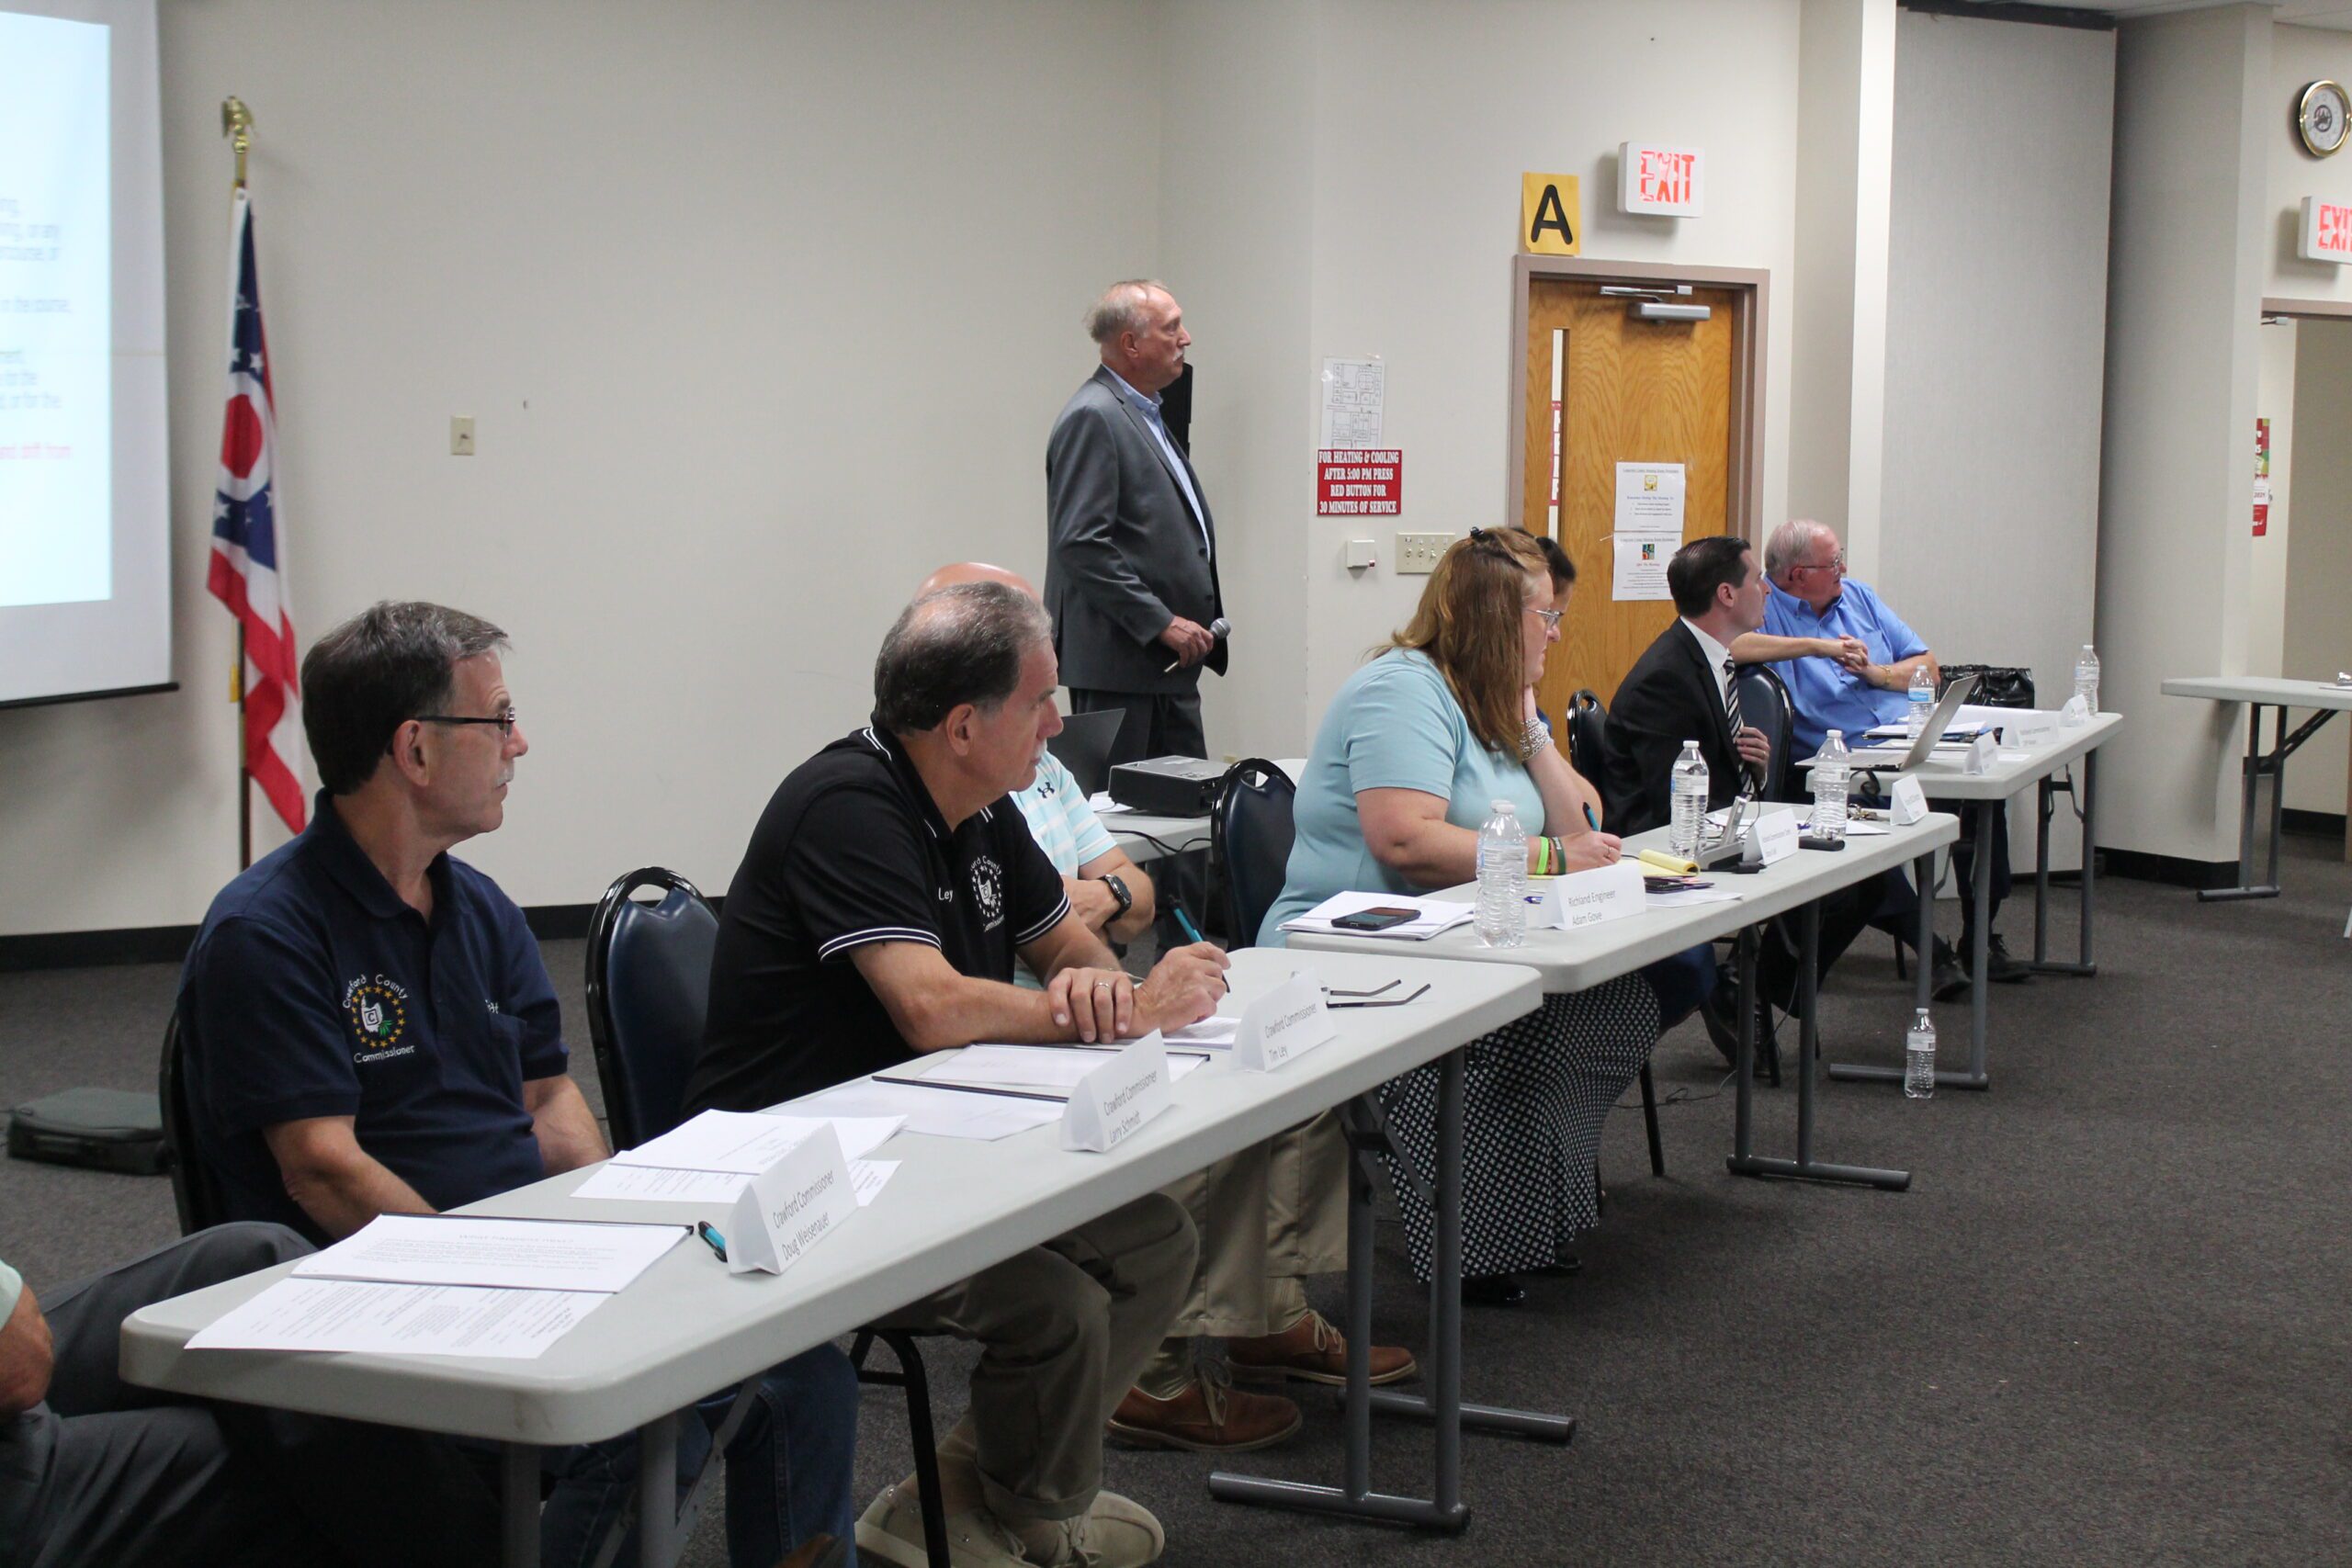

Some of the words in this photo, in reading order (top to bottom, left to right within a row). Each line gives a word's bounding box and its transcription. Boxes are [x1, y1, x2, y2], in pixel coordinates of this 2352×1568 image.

[1639, 150, 1695, 205] EXIT
[1530, 184, 1574, 245] A
[1318, 451, 1332, 464] FOR
[1333, 451, 1363, 464] HEATING
[1363, 451, 1370, 464] &
[1371, 451, 1399, 464] COOLING
[1324, 468, 1346, 480] AFTER
[1347, 468, 1360, 480] 5:00
[1361, 468, 1372, 480] PM
[1373, 468, 1394, 480] PRESS
[1329, 484, 1344, 497] RED
[1345, 484, 1372, 497] BUTTON
[1373, 484, 1386, 497] FOR
[1319, 501, 1328, 513] 30
[1329, 501, 1358, 513] MINUTES
[1359, 501, 1368, 513] OF
[1369, 501, 1396, 513] SERVICE
[938, 886, 954, 903] Ley
[1591, 890, 1616, 904] Engineer
[375, 974, 408, 999] County
[1283, 1003, 1317, 1028] Commissioner
[354, 1044, 416, 1064] Commissioner
[1103, 1088, 1127, 1116] Crawford
[1125, 1070, 1158, 1102] Commissioner
[773, 1194, 799, 1229] Crawford
[797, 1170, 836, 1210] Commissioner
[781, 1236, 801, 1261] Doug
[795, 1211, 831, 1248] Weisenauer
